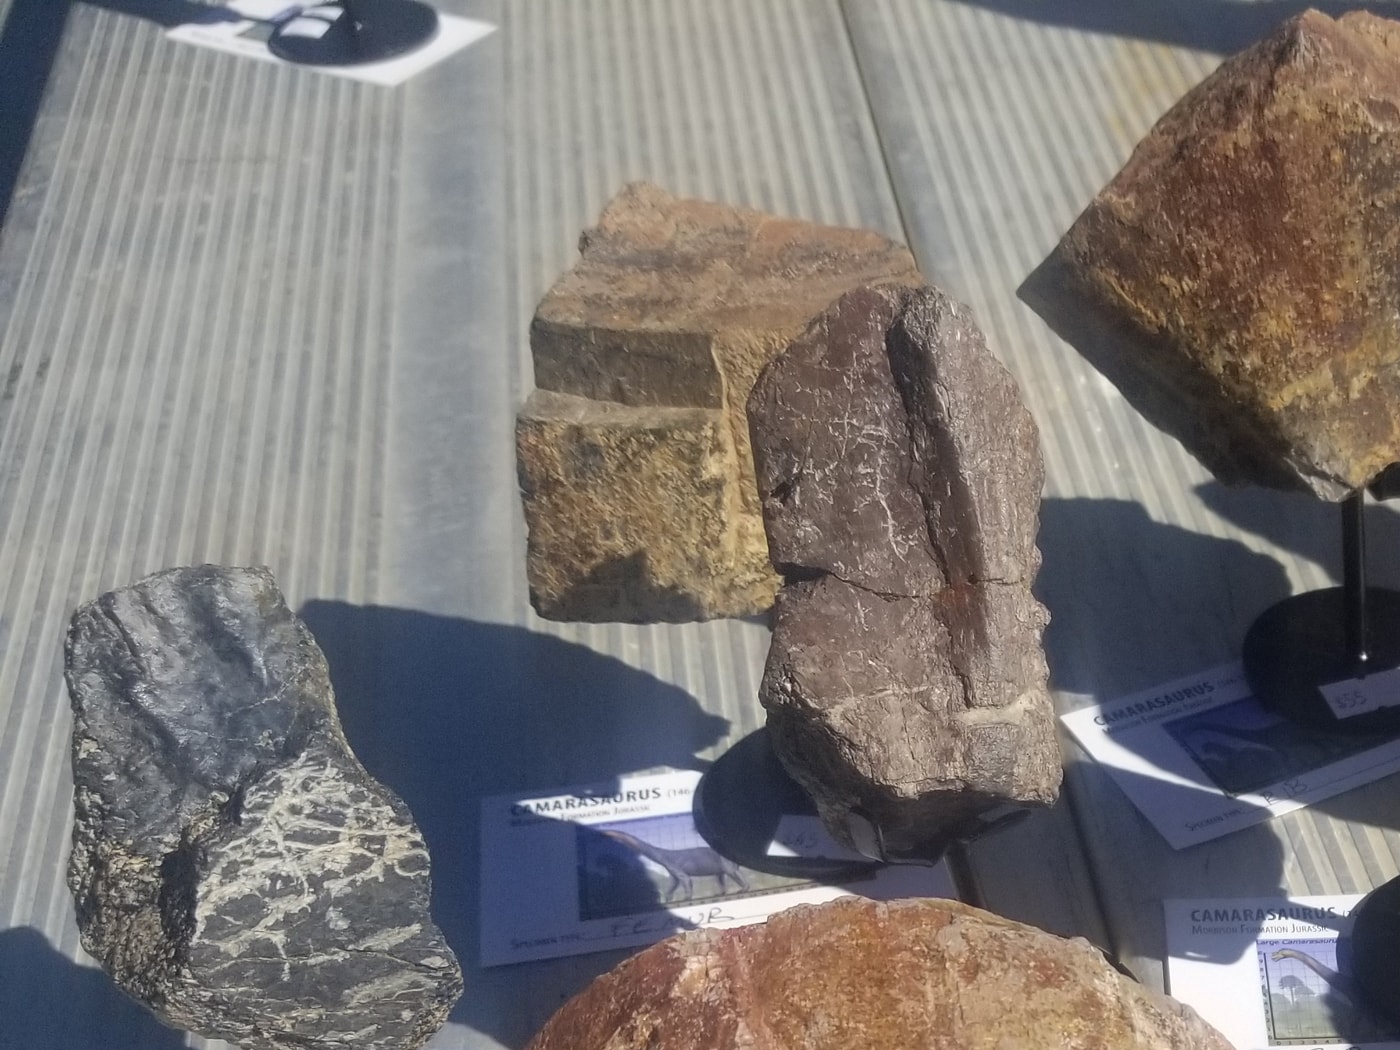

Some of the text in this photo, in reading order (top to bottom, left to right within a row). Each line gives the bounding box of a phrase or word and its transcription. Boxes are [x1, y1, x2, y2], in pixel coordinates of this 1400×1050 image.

[1094, 681, 1216, 726] CAMARASAURUS
[511, 787, 695, 816] CAMARASAURUS (146-
[1191, 907, 1336, 923] CAMARASAURUS
[1241, 923, 1288, 934] FORMATION
[1291, 922, 1330, 934] JURASSIC
